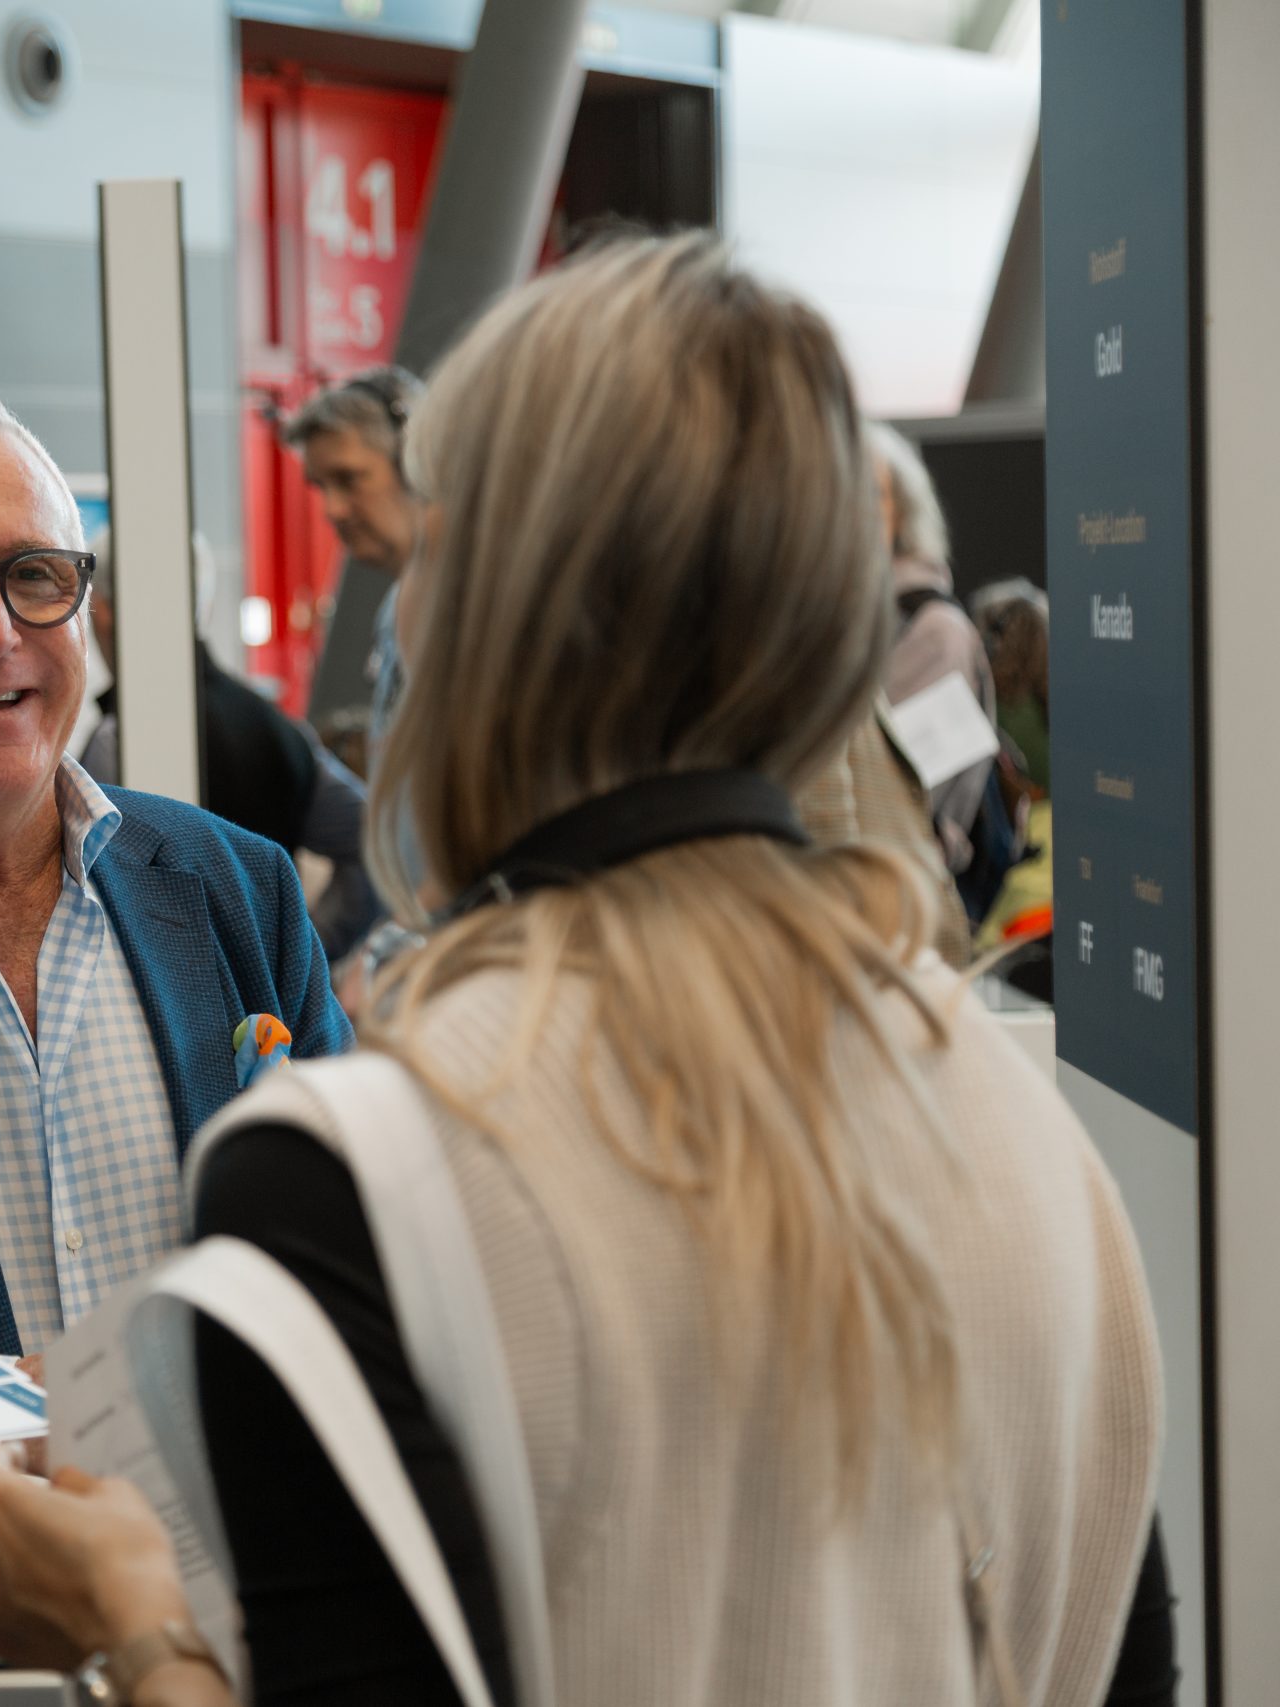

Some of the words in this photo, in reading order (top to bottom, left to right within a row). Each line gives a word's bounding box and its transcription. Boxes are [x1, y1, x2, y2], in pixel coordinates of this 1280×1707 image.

[306, 155, 397, 262] 4.1
[1095, 324, 1123, 377] Gold
[1090, 593, 1134, 641] Kanada
[1079, 921, 1094, 964] FF
[1133, 947, 1165, 1001] FMG
